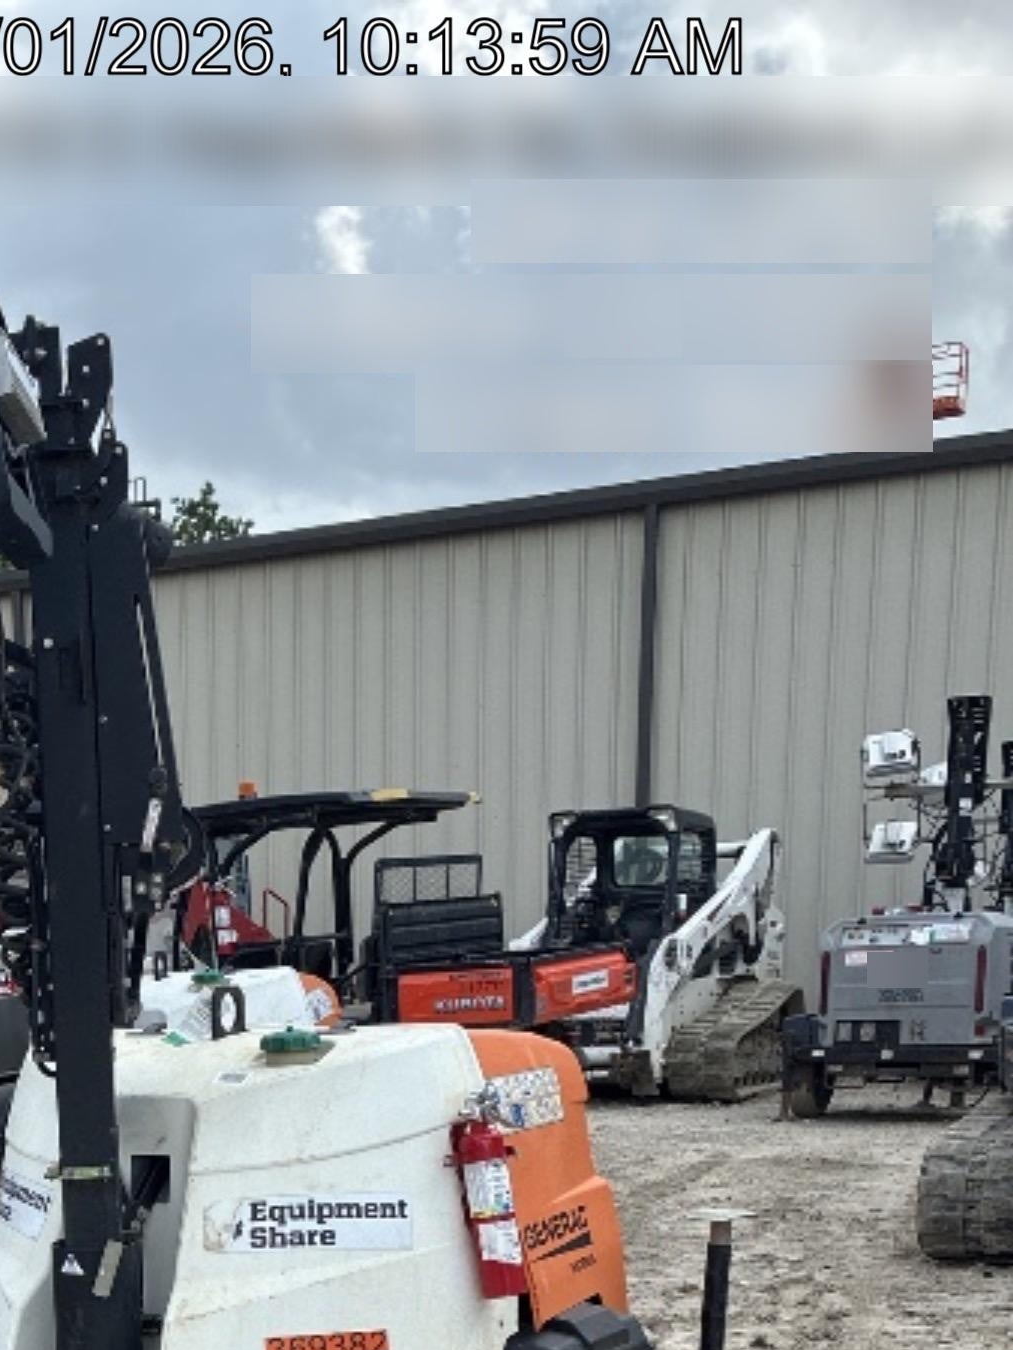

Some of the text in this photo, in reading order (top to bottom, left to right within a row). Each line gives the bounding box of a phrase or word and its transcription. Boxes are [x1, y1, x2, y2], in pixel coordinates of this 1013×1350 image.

[250, 1199, 408, 1226] Equipment
[250, 1226, 336, 1249] Share
[524, 1205, 588, 1249] GENERAC
